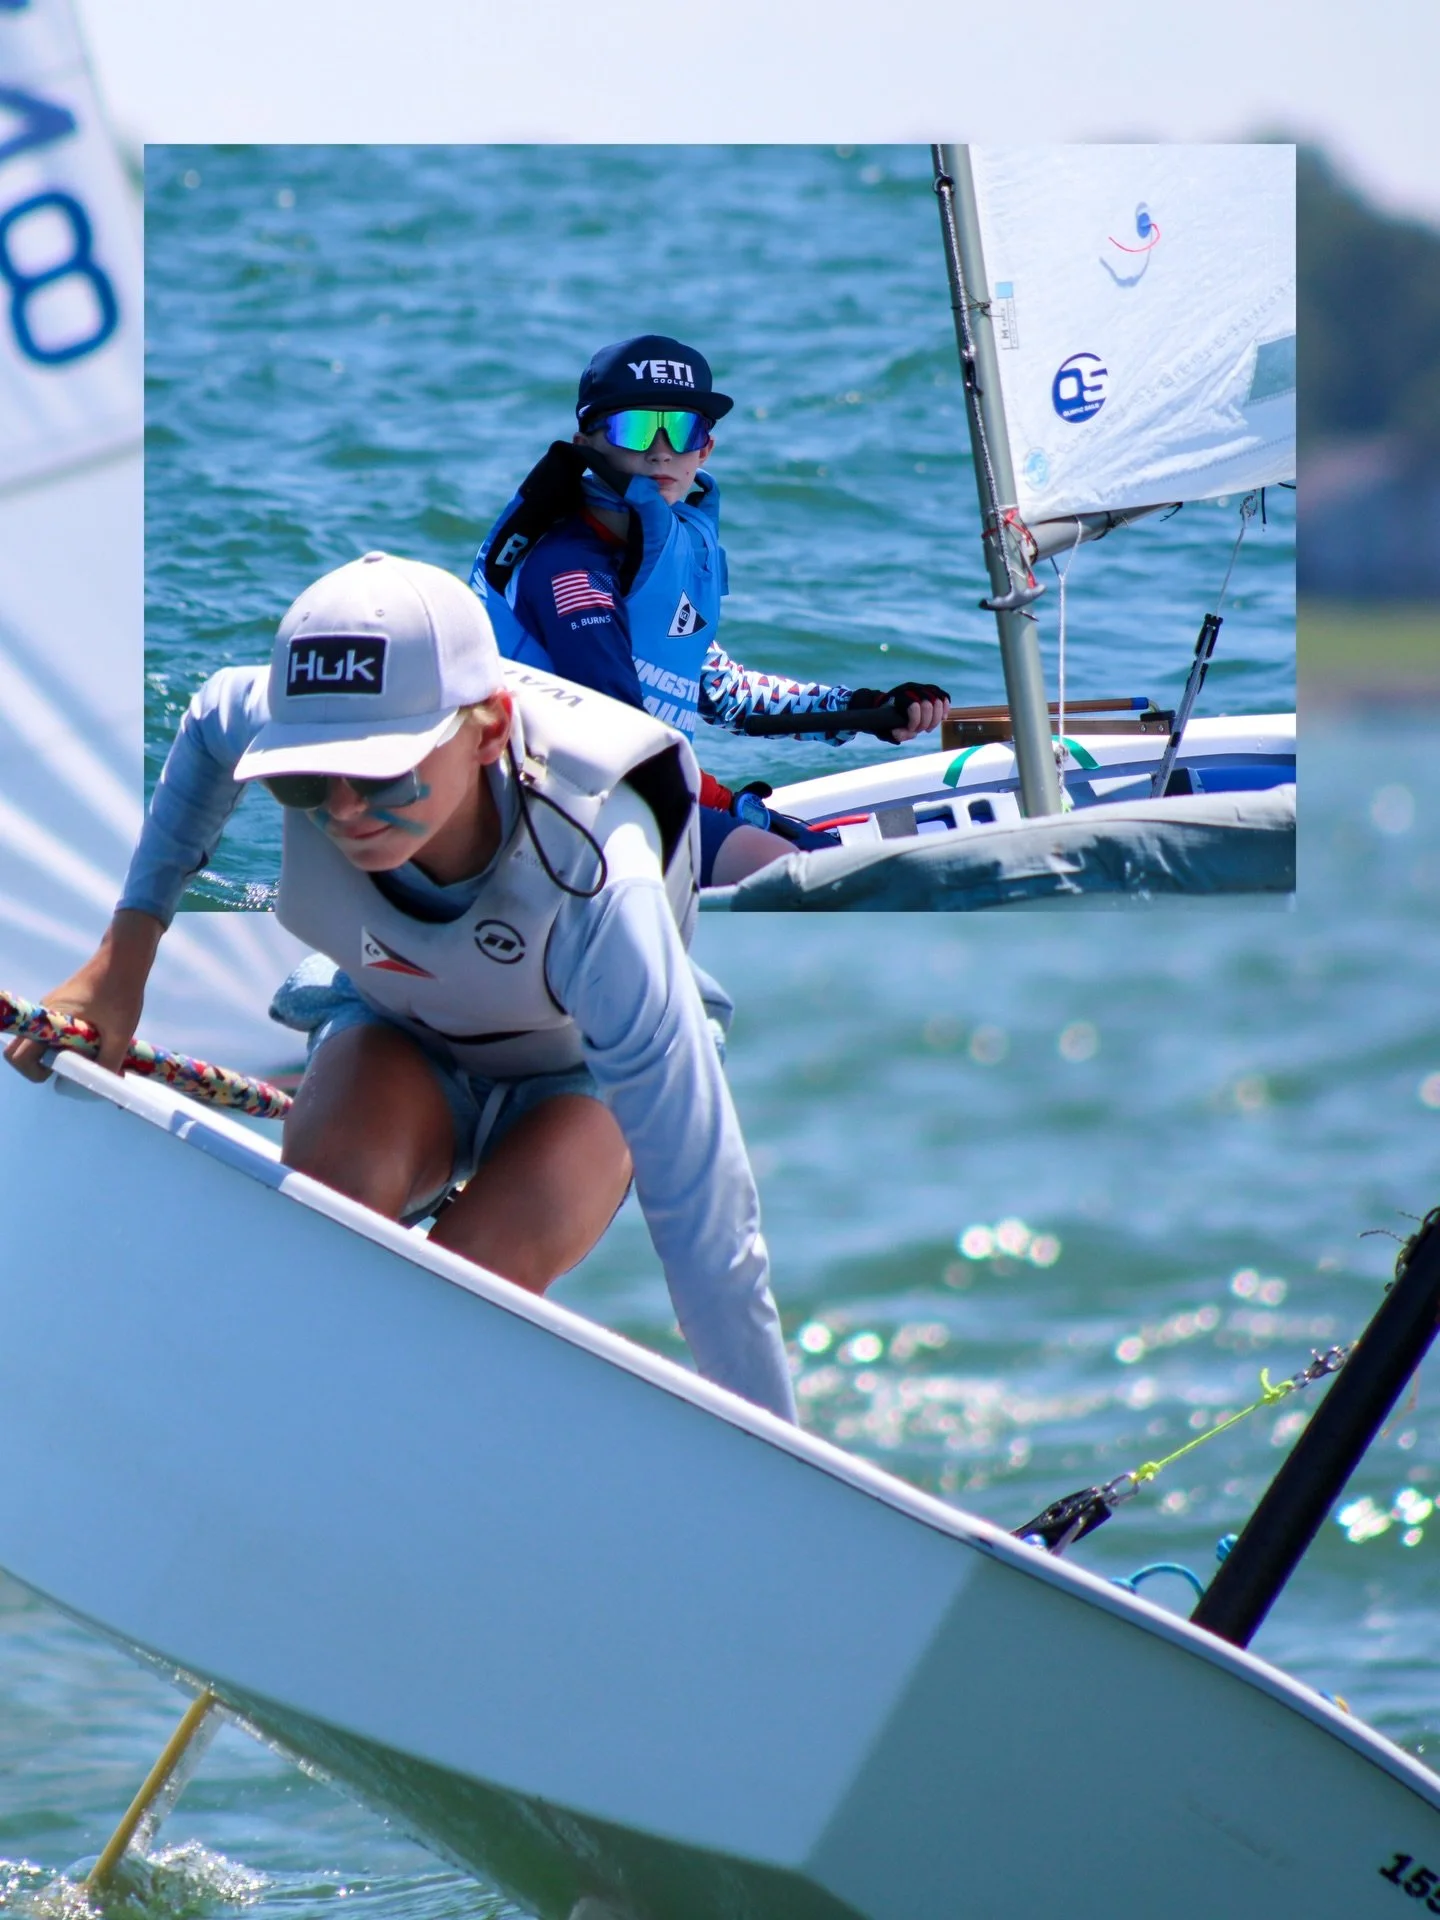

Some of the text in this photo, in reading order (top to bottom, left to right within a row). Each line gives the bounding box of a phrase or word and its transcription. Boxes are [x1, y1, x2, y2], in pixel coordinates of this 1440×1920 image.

[627, 359, 695, 383] YETI
[653, 377, 696, 389] COOLERS
[570, 614, 612, 631] B. BURNS
[631, 656, 700, 704] INGST
